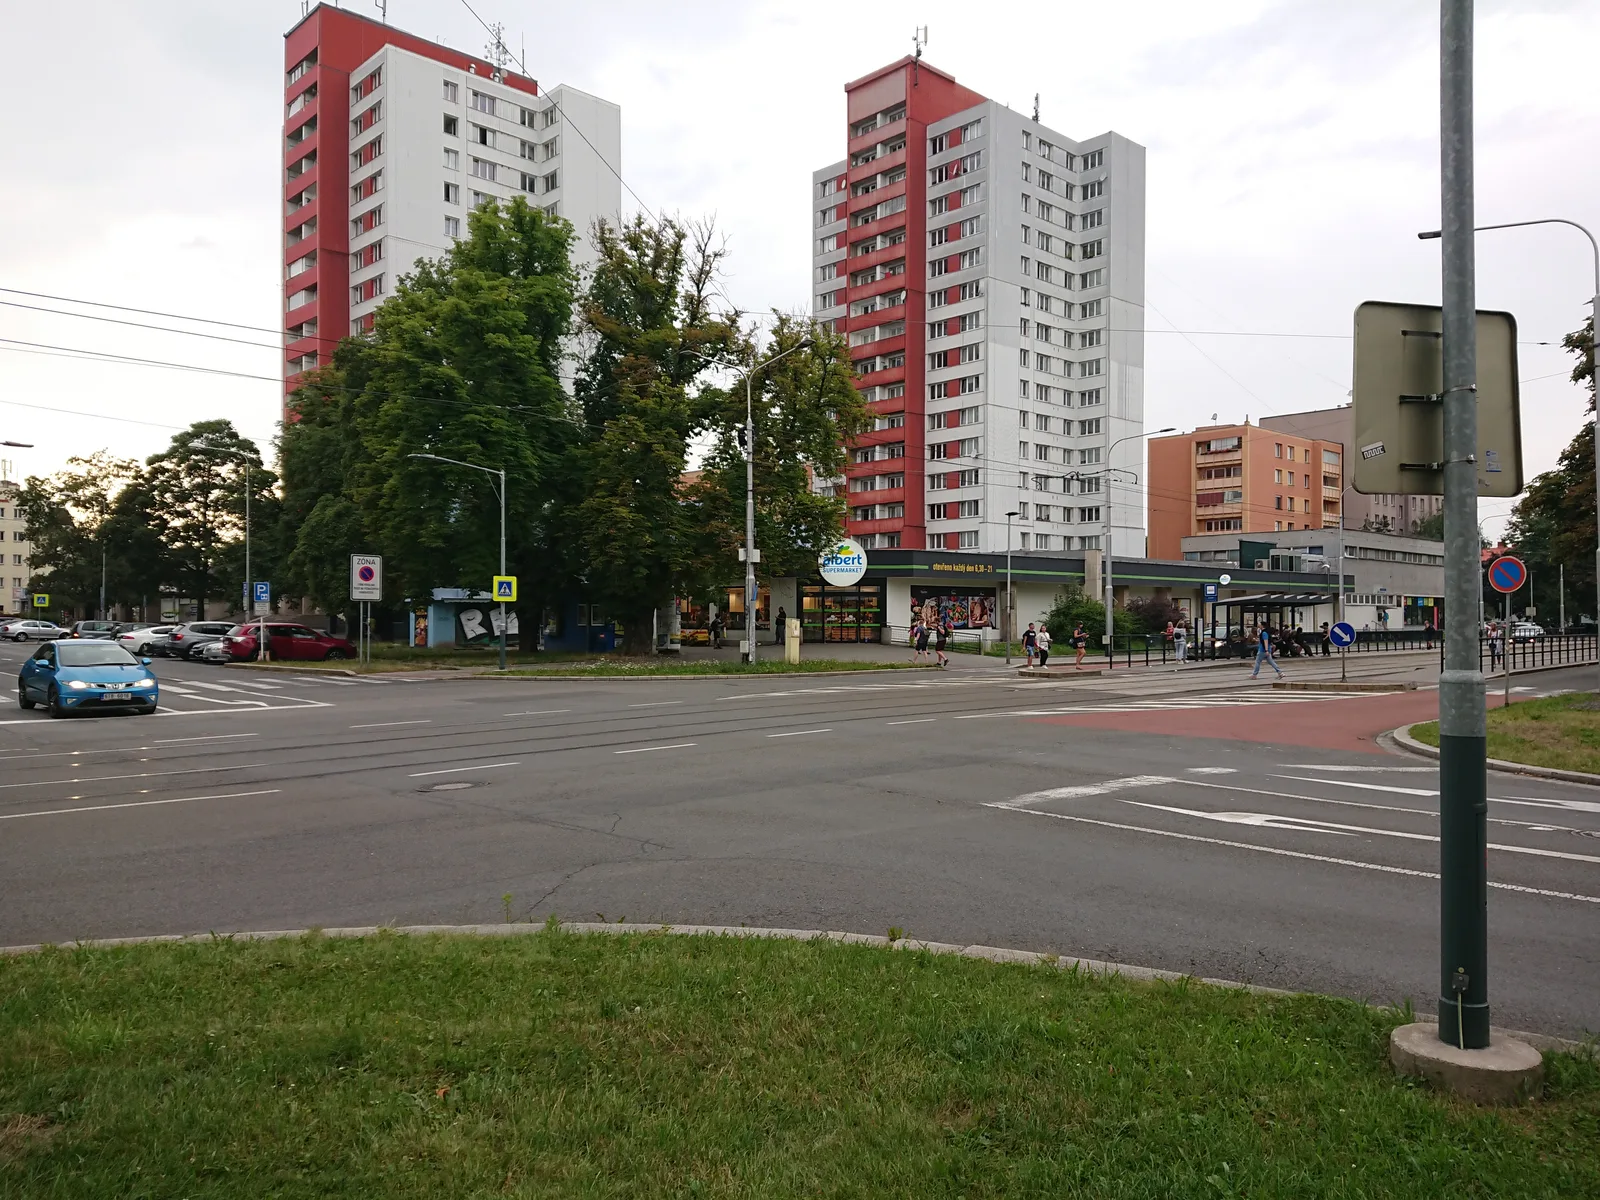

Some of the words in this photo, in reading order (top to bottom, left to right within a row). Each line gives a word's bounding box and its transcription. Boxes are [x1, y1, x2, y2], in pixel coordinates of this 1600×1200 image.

[823, 554, 862, 565] albert
[933, 563, 952, 571] otevřeno
[953, 563, 965, 573] každý
[966, 564, 974, 572] den
[257, 585, 266, 595] P
